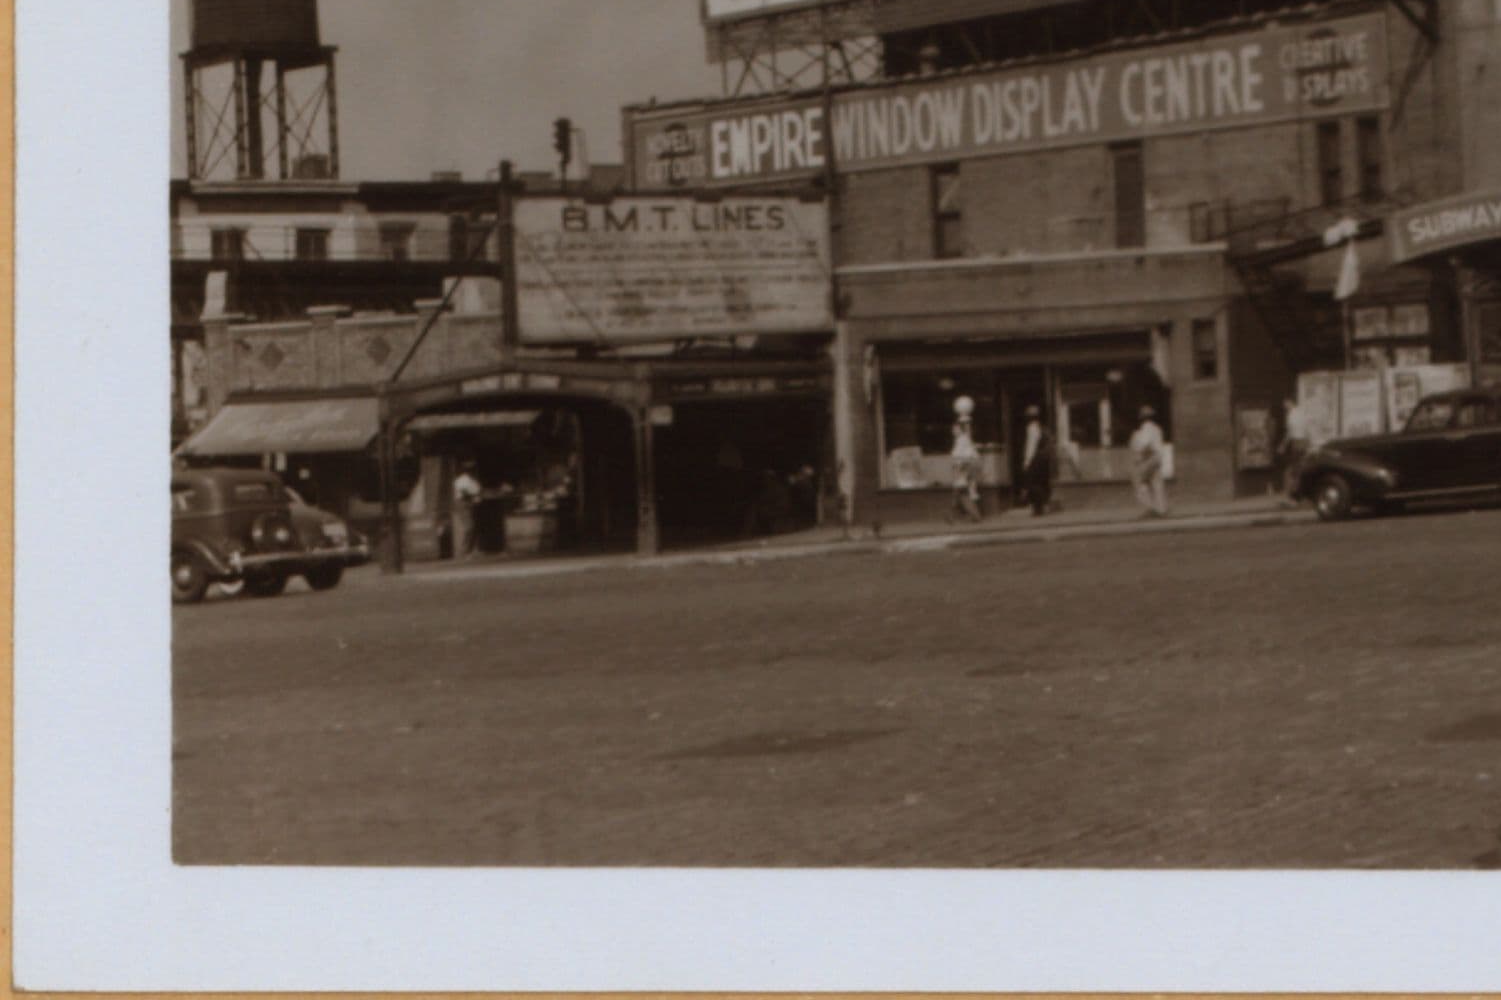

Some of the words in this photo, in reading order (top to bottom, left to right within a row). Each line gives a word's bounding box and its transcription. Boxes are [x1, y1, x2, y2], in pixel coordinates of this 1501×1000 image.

[711, 107, 826, 179] EMPIRE
[831, 83, 968, 162] WINDOW
[972, 66, 1105, 146] DISPLAY
[1120, 44, 1265, 126] CENTRE
[691, 204, 786, 231] LINES
